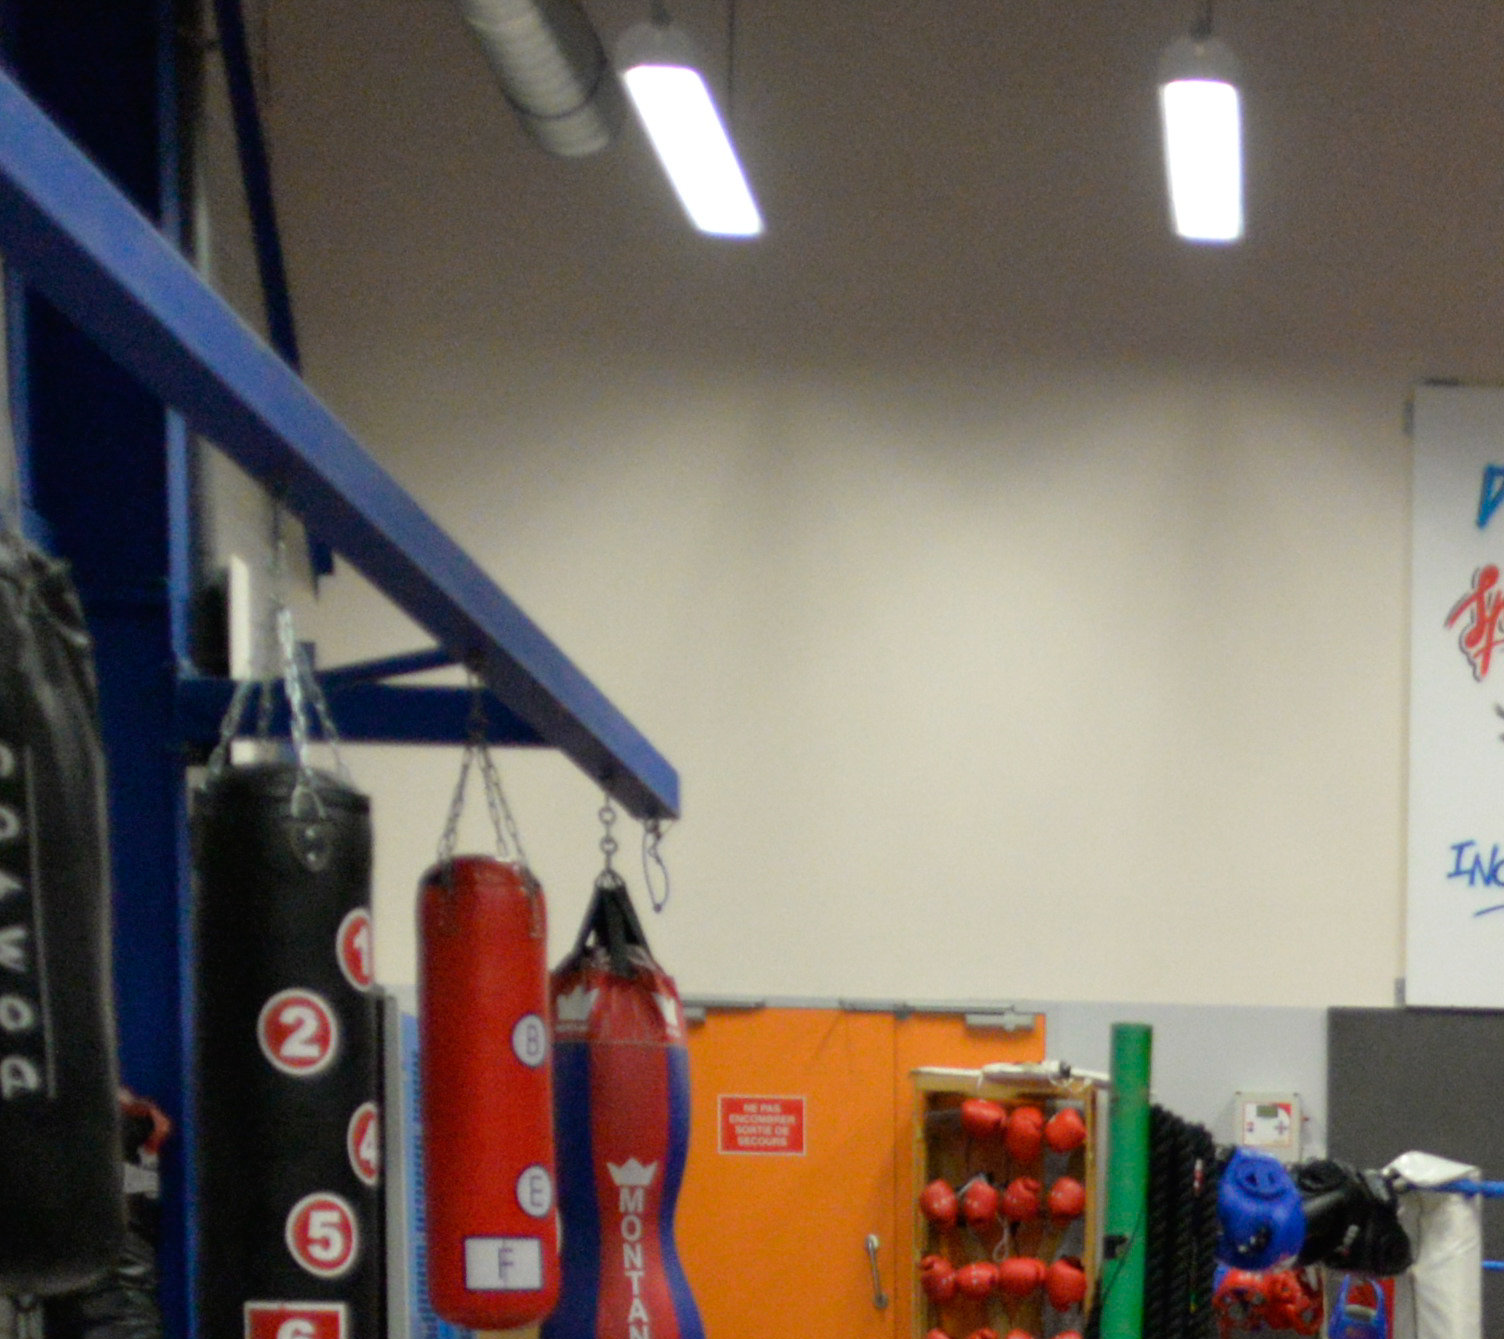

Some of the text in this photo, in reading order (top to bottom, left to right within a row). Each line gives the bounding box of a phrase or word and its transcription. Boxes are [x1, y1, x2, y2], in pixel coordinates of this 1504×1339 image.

[279, 1005, 320, 1059] 2
[525, 1024, 540, 1056] B
[529, 1175, 544, 1208] E
[307, 1210, 343, 1262] 5
